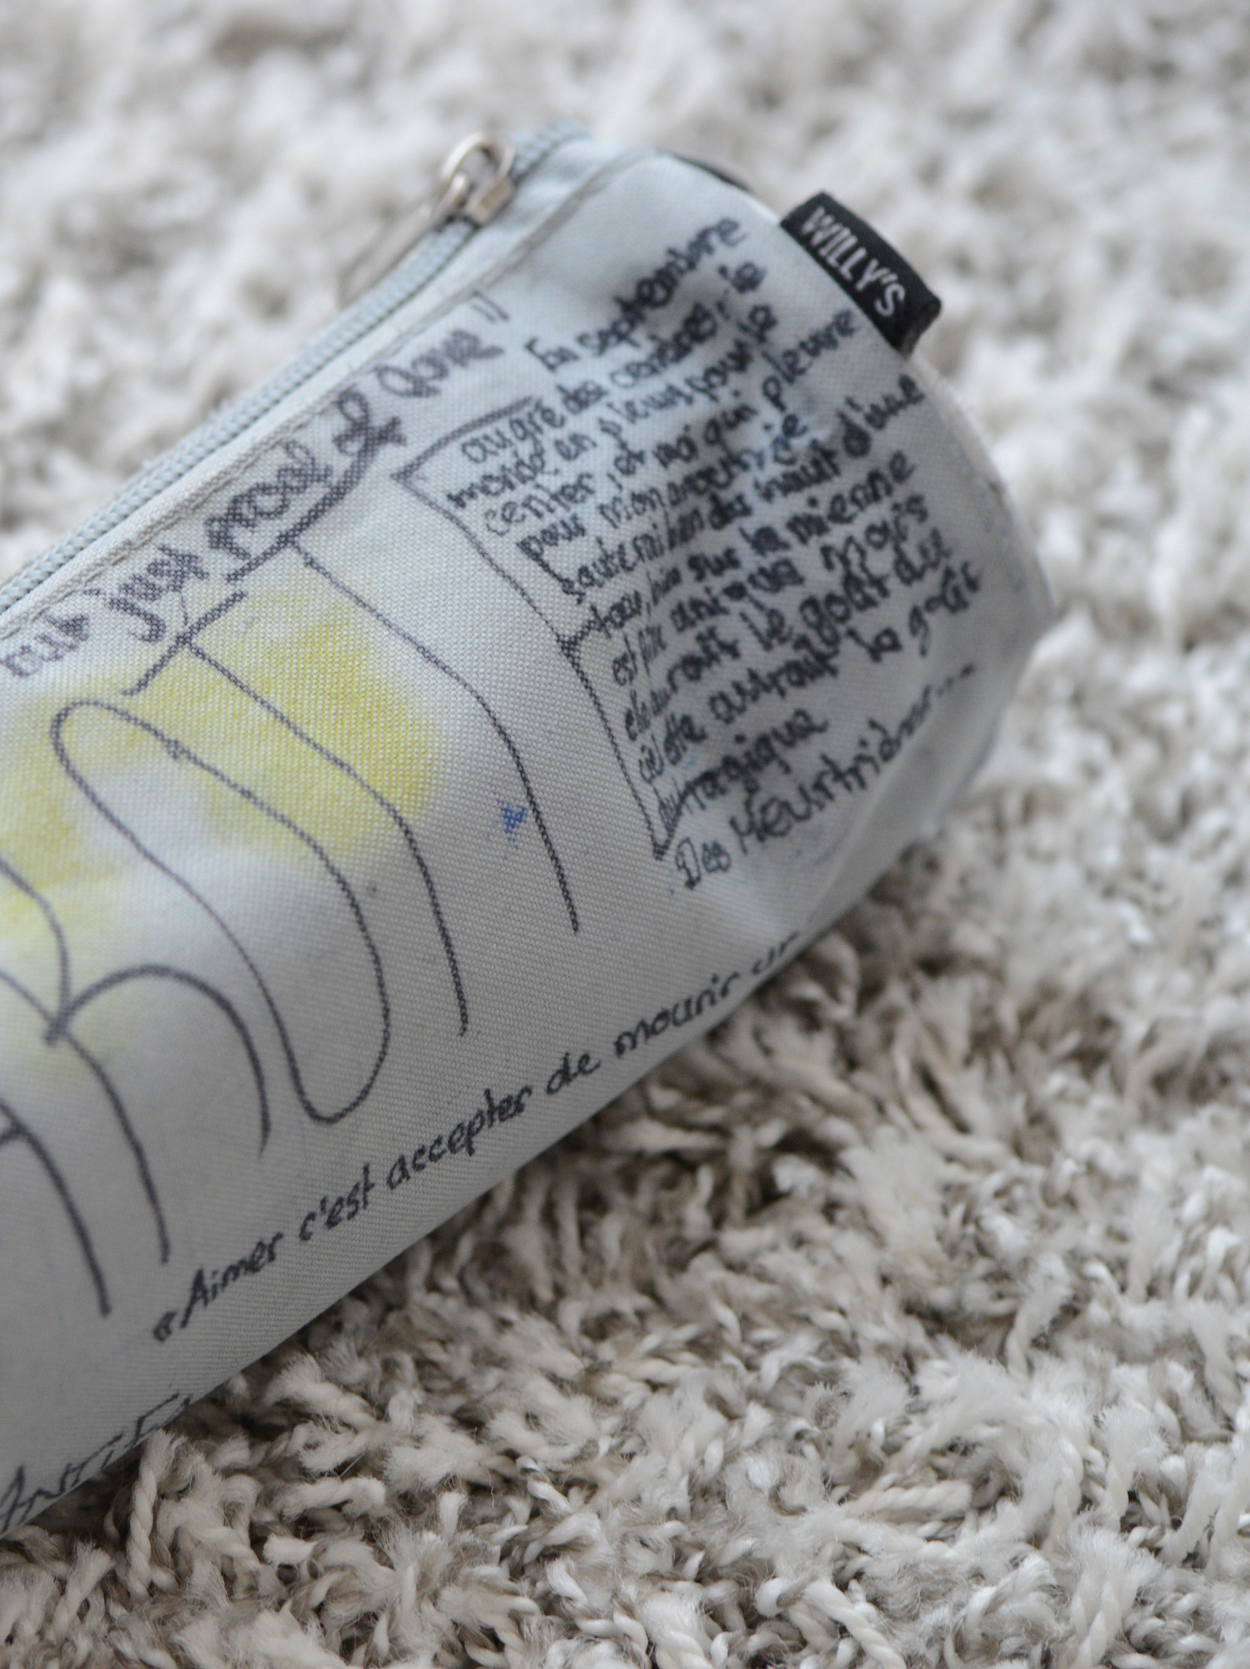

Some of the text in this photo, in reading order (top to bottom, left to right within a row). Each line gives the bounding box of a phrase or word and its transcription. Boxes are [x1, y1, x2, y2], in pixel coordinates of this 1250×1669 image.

[801, 206, 906, 318] WILLY'S
[297, 1163, 374, 1245] c'est
[385, 1083, 534, 1192] accepter
[544, 1050, 603, 1098] de
[613, 970, 742, 1057] mourir
